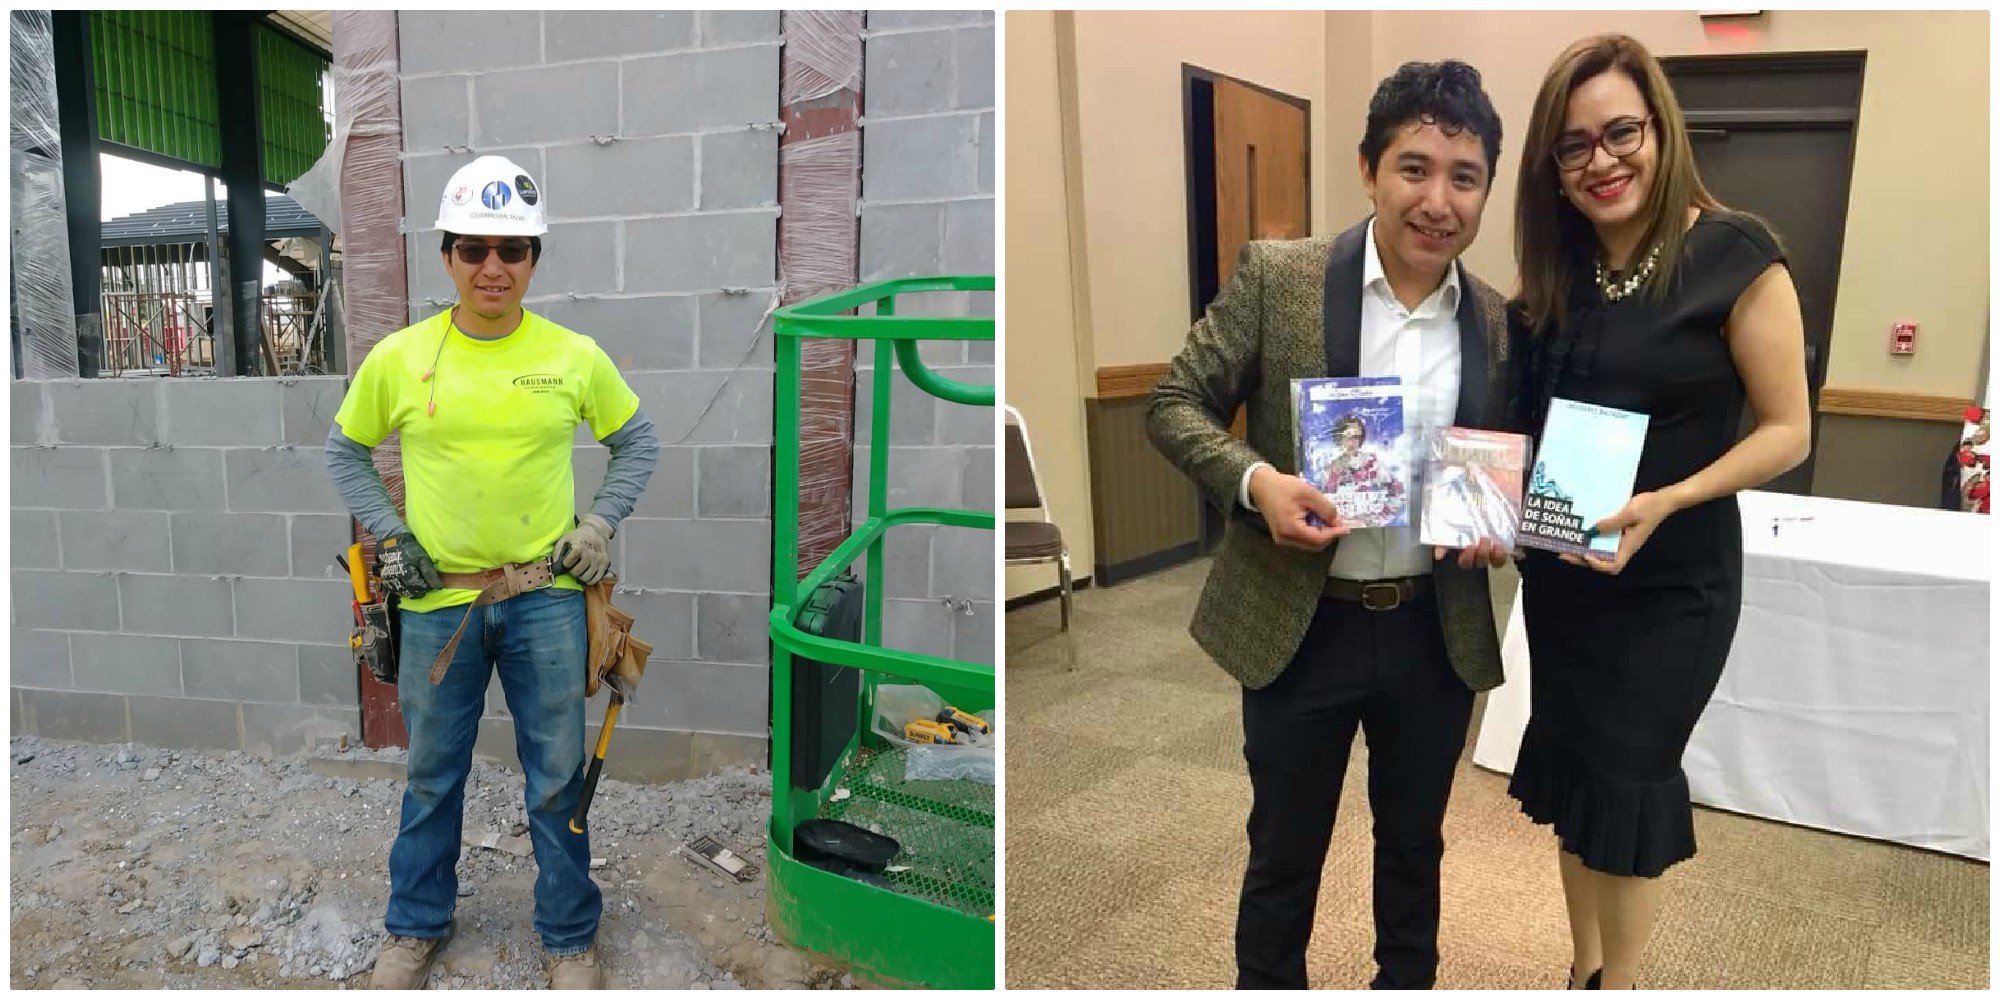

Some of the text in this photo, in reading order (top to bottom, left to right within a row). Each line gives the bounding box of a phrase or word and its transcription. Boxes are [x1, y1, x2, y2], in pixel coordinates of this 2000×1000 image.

[520, 378, 563, 386] HAUSMANN
[1528, 497, 1571, 514] LA IDEA
[1525, 508, 1540, 520] DE
[1521, 521, 1538, 534] EN
[1539, 523, 1584, 543] GRANDE
